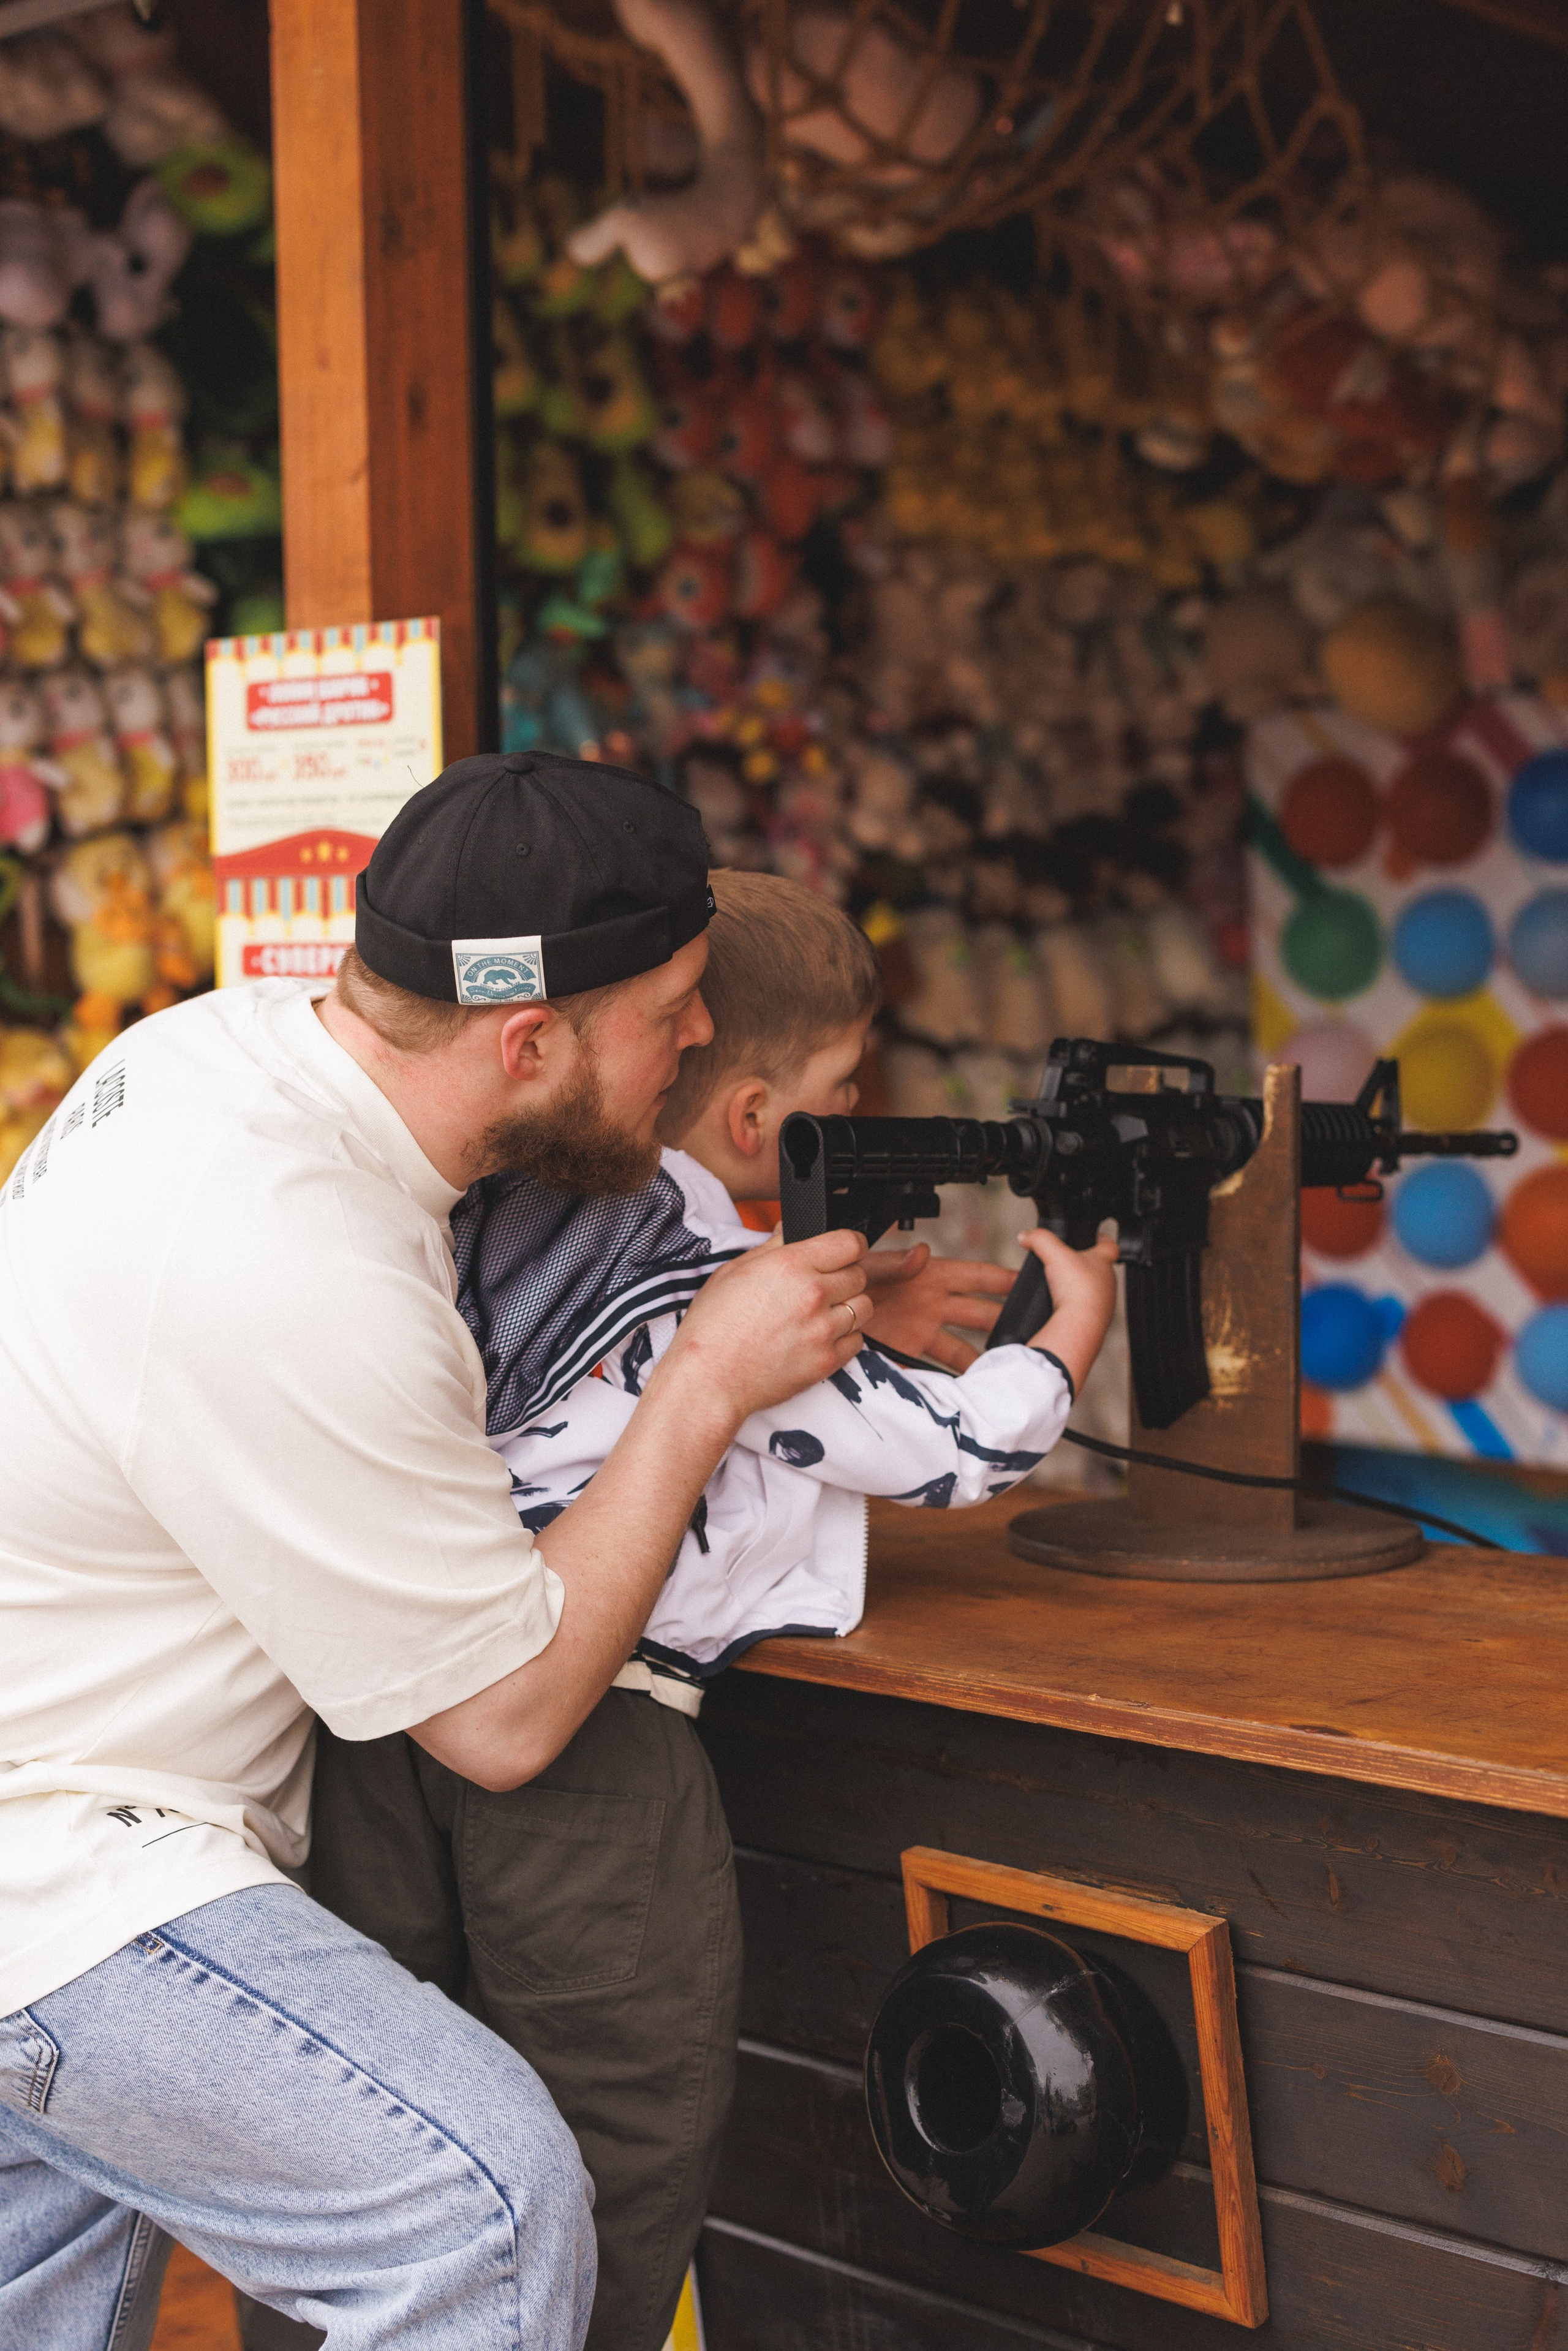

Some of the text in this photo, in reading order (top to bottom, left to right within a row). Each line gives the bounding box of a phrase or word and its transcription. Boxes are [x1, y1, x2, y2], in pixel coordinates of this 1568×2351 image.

[467, 958, 529, 976] ON THE MOMENT
[92, 1059, 126, 1129] LACOSTE
